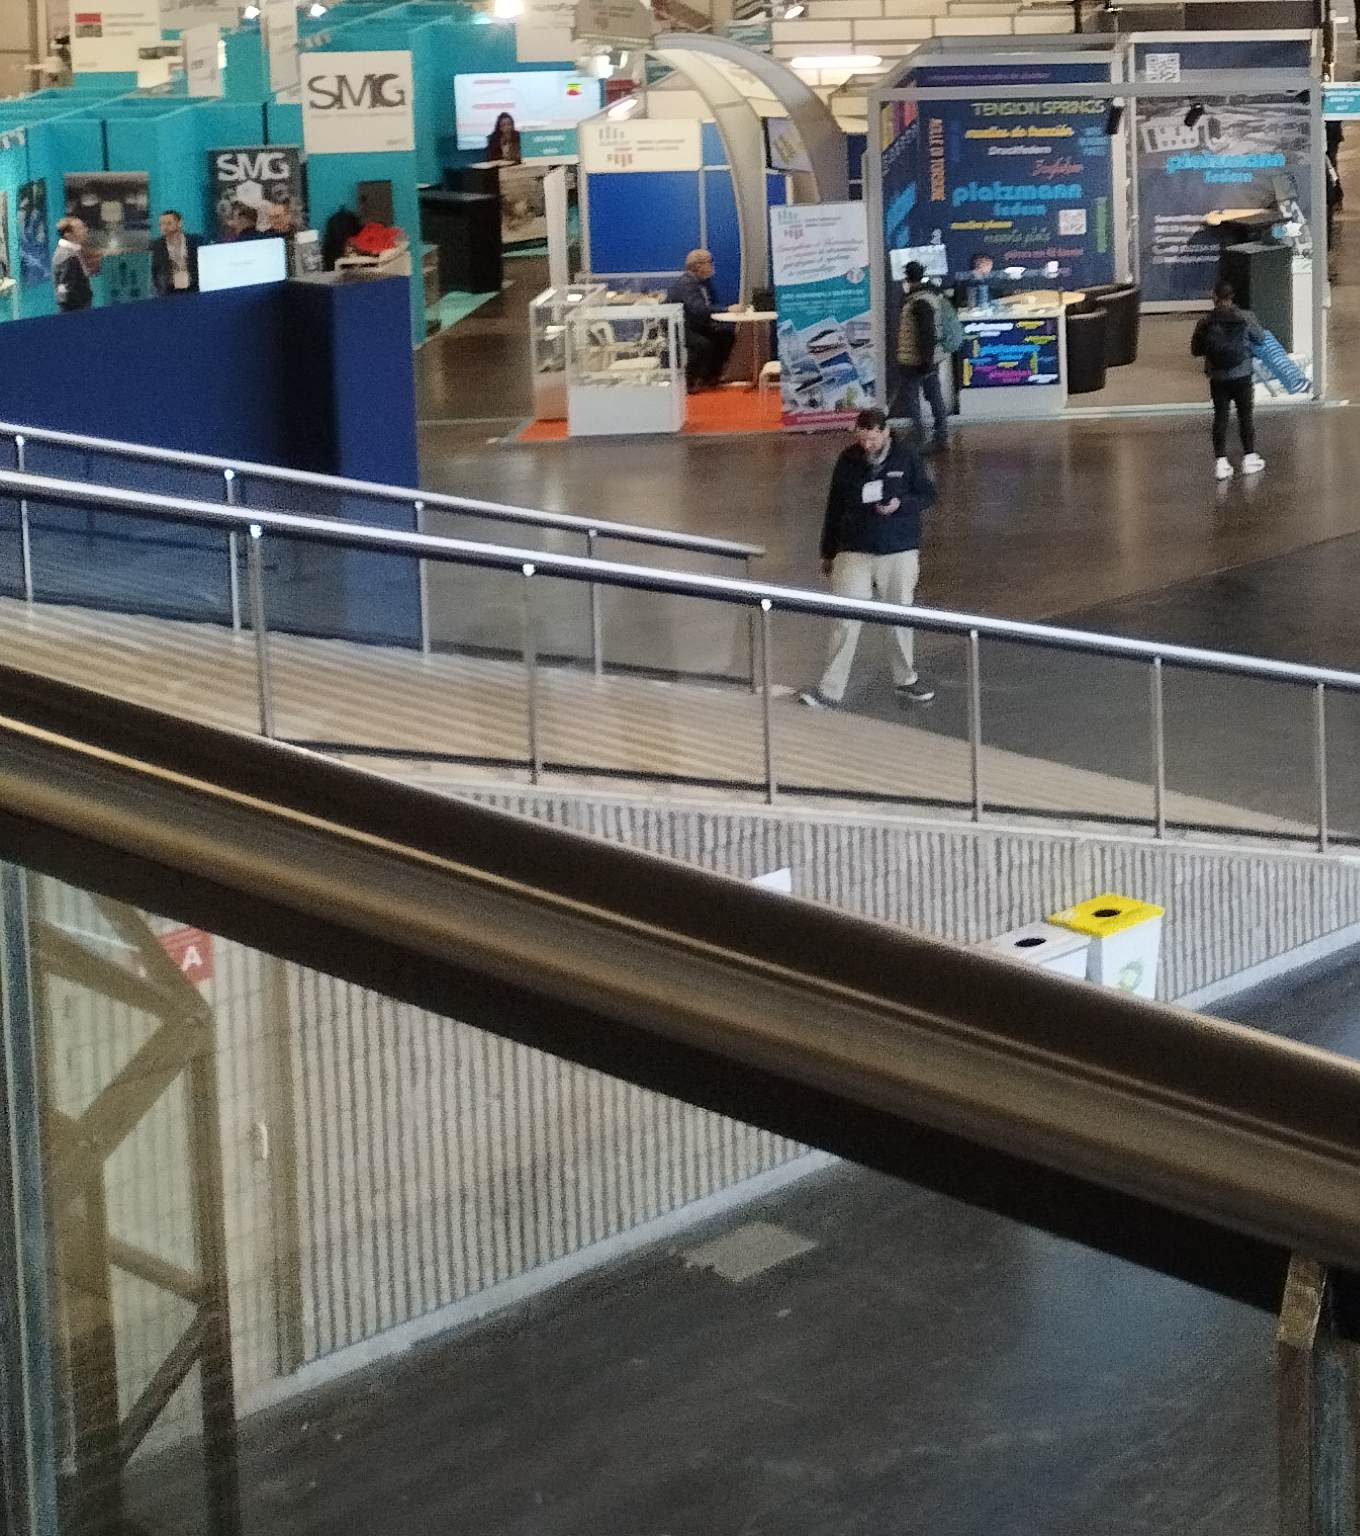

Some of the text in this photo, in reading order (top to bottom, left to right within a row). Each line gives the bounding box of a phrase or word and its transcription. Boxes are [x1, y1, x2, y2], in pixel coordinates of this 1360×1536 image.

[307, 72, 406, 111] SMG
[970, 102, 1040, 116] TENSION
[215, 151, 291, 183] SMG
[181, 944, 203, 972] A
